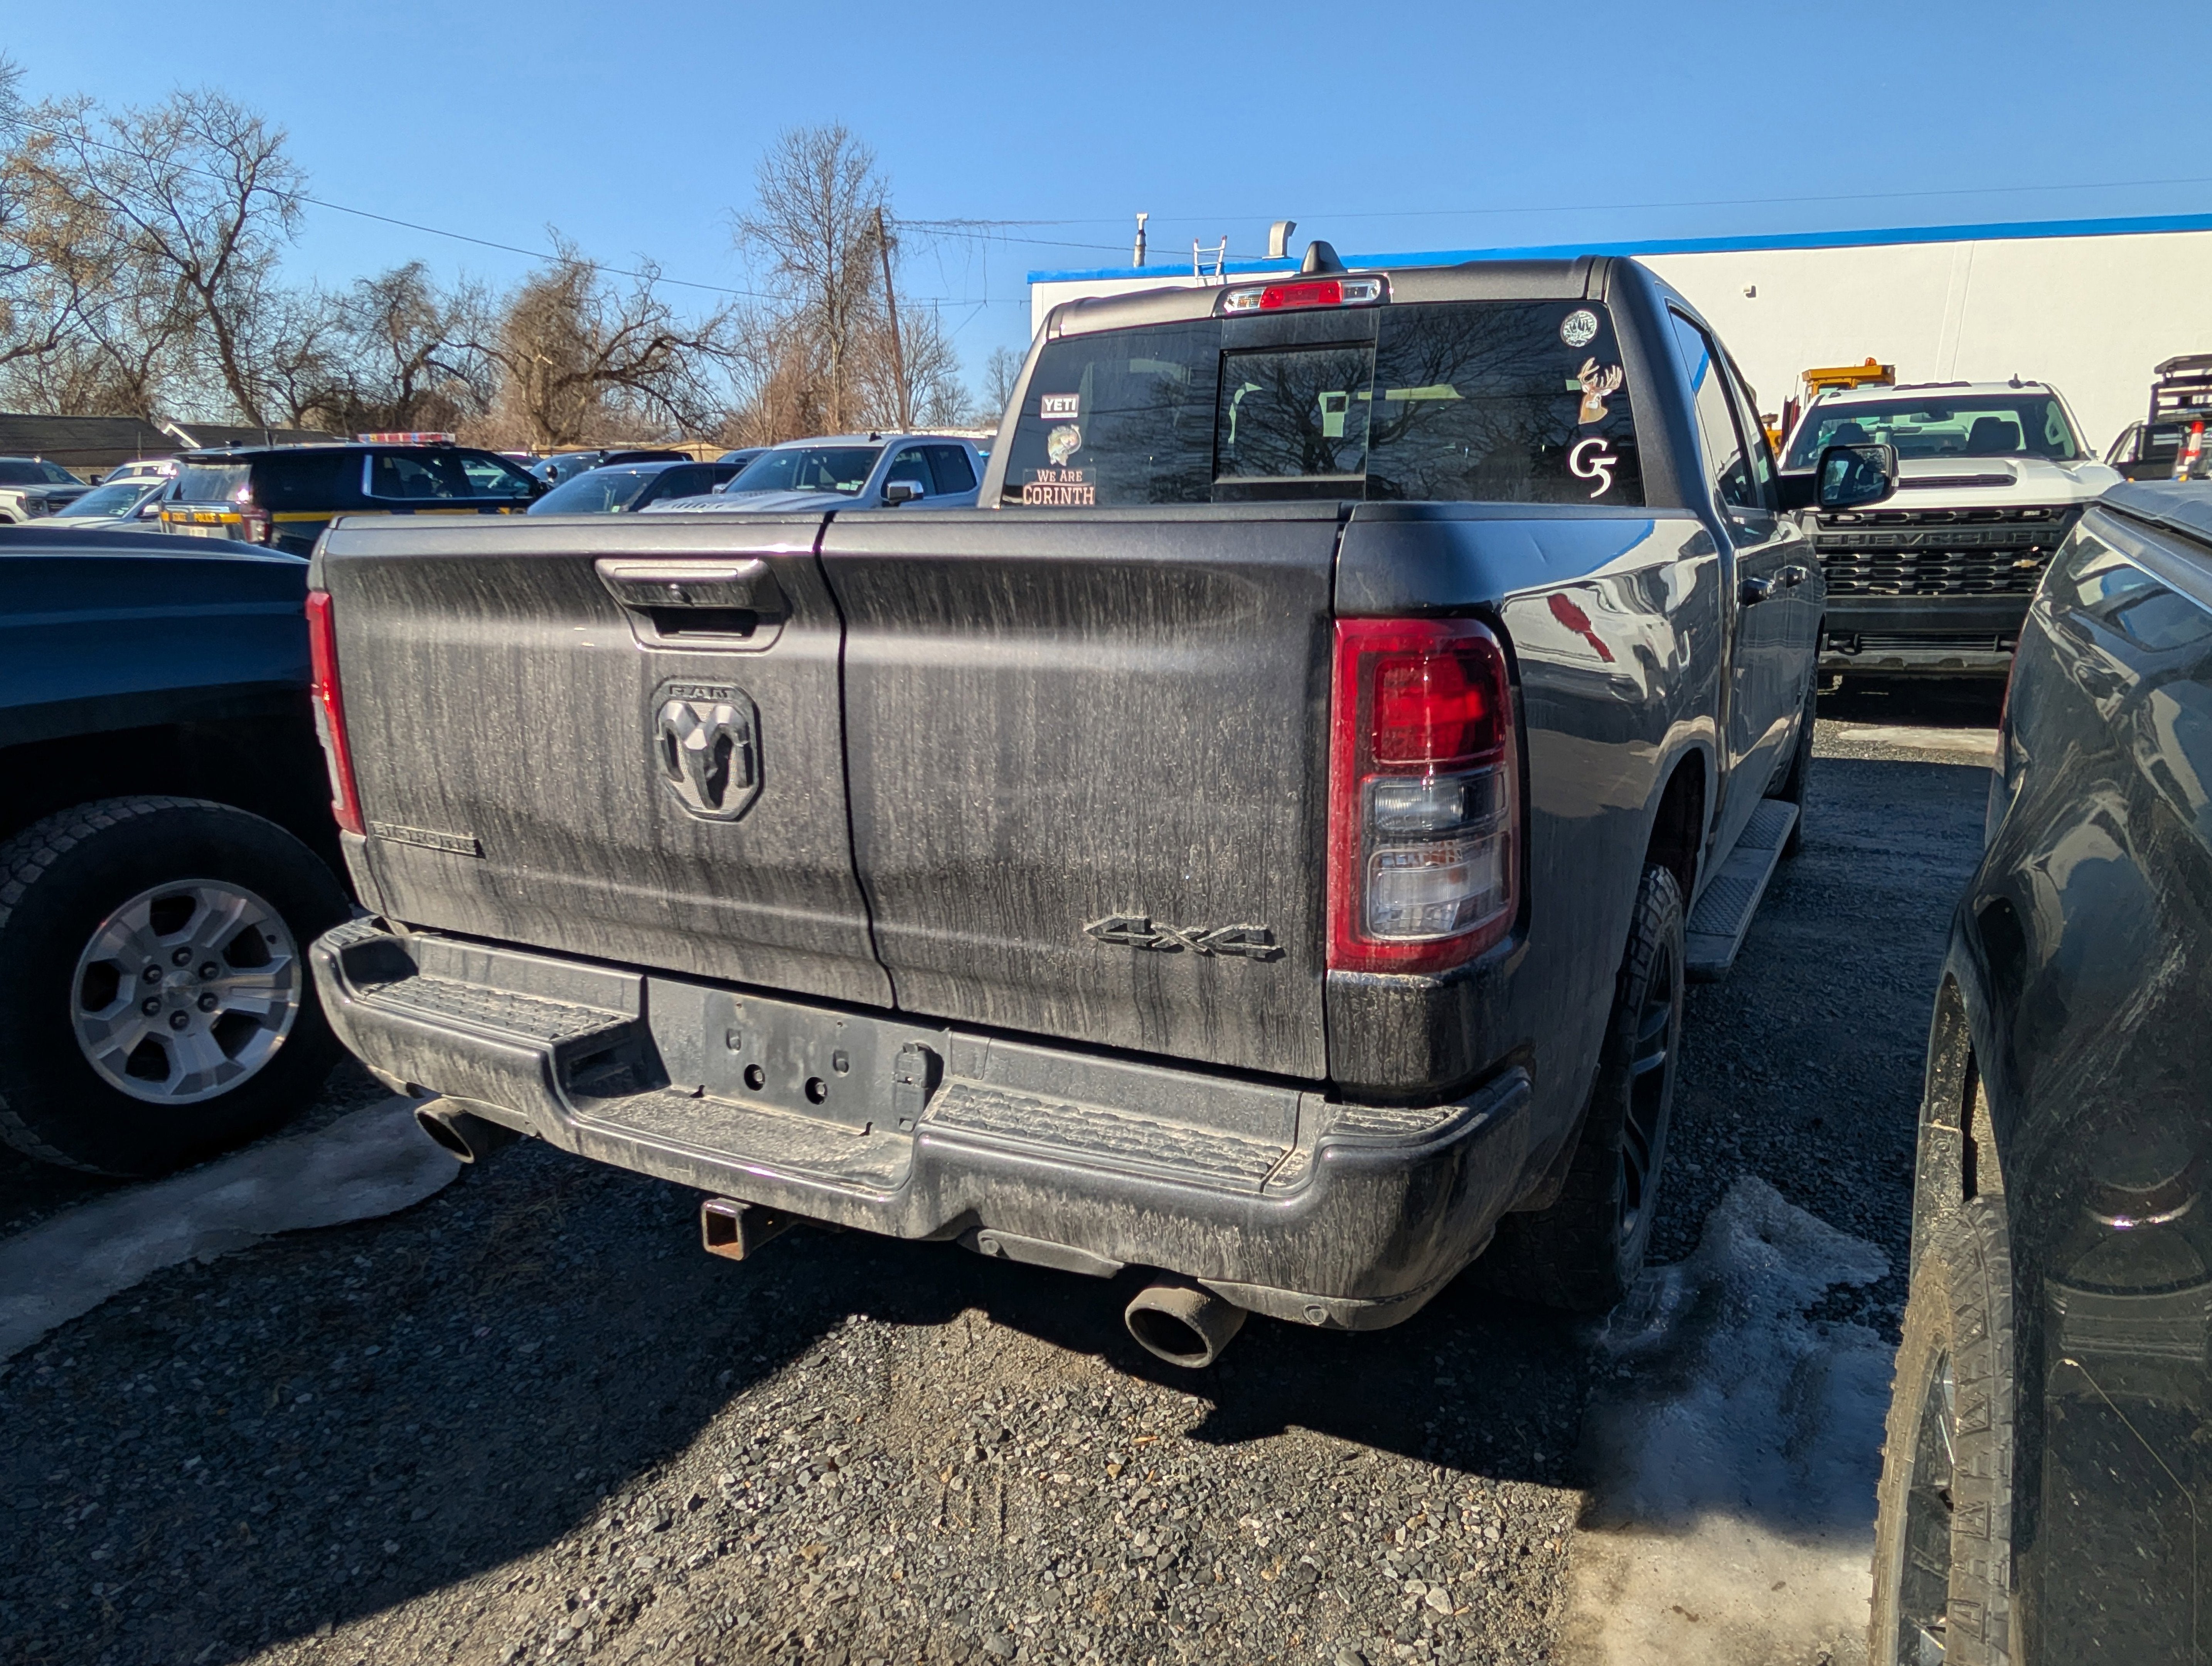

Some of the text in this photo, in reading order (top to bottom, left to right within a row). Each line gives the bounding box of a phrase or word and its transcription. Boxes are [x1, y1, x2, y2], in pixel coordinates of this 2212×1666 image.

[1044, 397, 1077, 411] YETI
[1037, 469, 1083, 482] WE ARE
[1024, 486, 1094, 505] CORINTH
[1817, 530, 2060, 547] CHEVROLET
[669, 685, 733, 700] RAM
